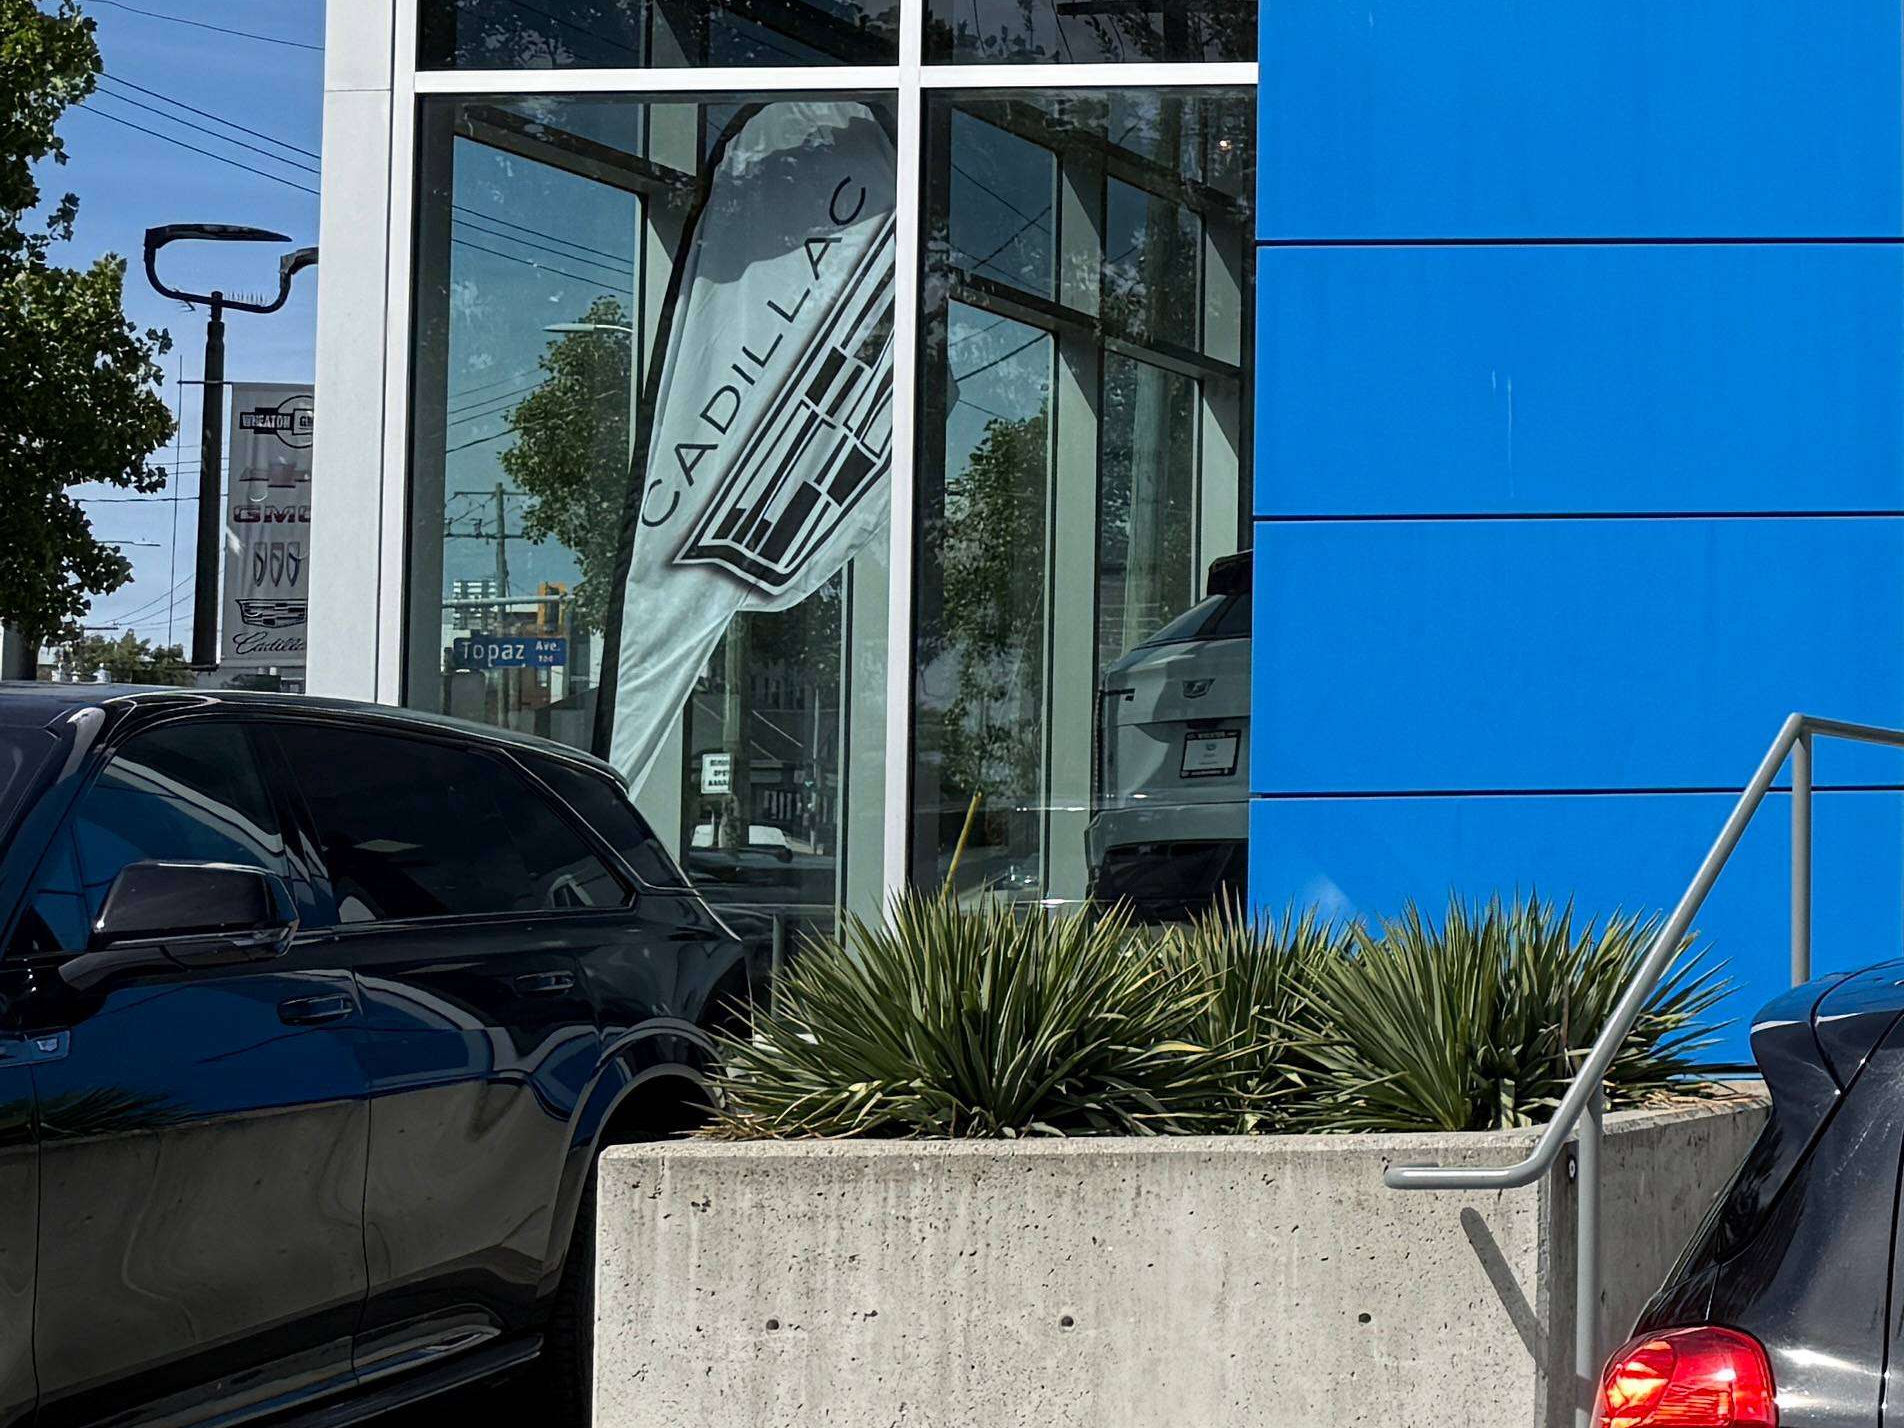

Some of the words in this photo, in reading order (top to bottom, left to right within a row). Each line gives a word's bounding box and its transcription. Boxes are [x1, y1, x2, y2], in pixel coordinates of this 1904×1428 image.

[641, 175, 866, 527] CADILLAC
[242, 413, 291, 429] WHEATON
[233, 631, 306, 654] Cadilla
[462, 642, 525, 667] Topaz
